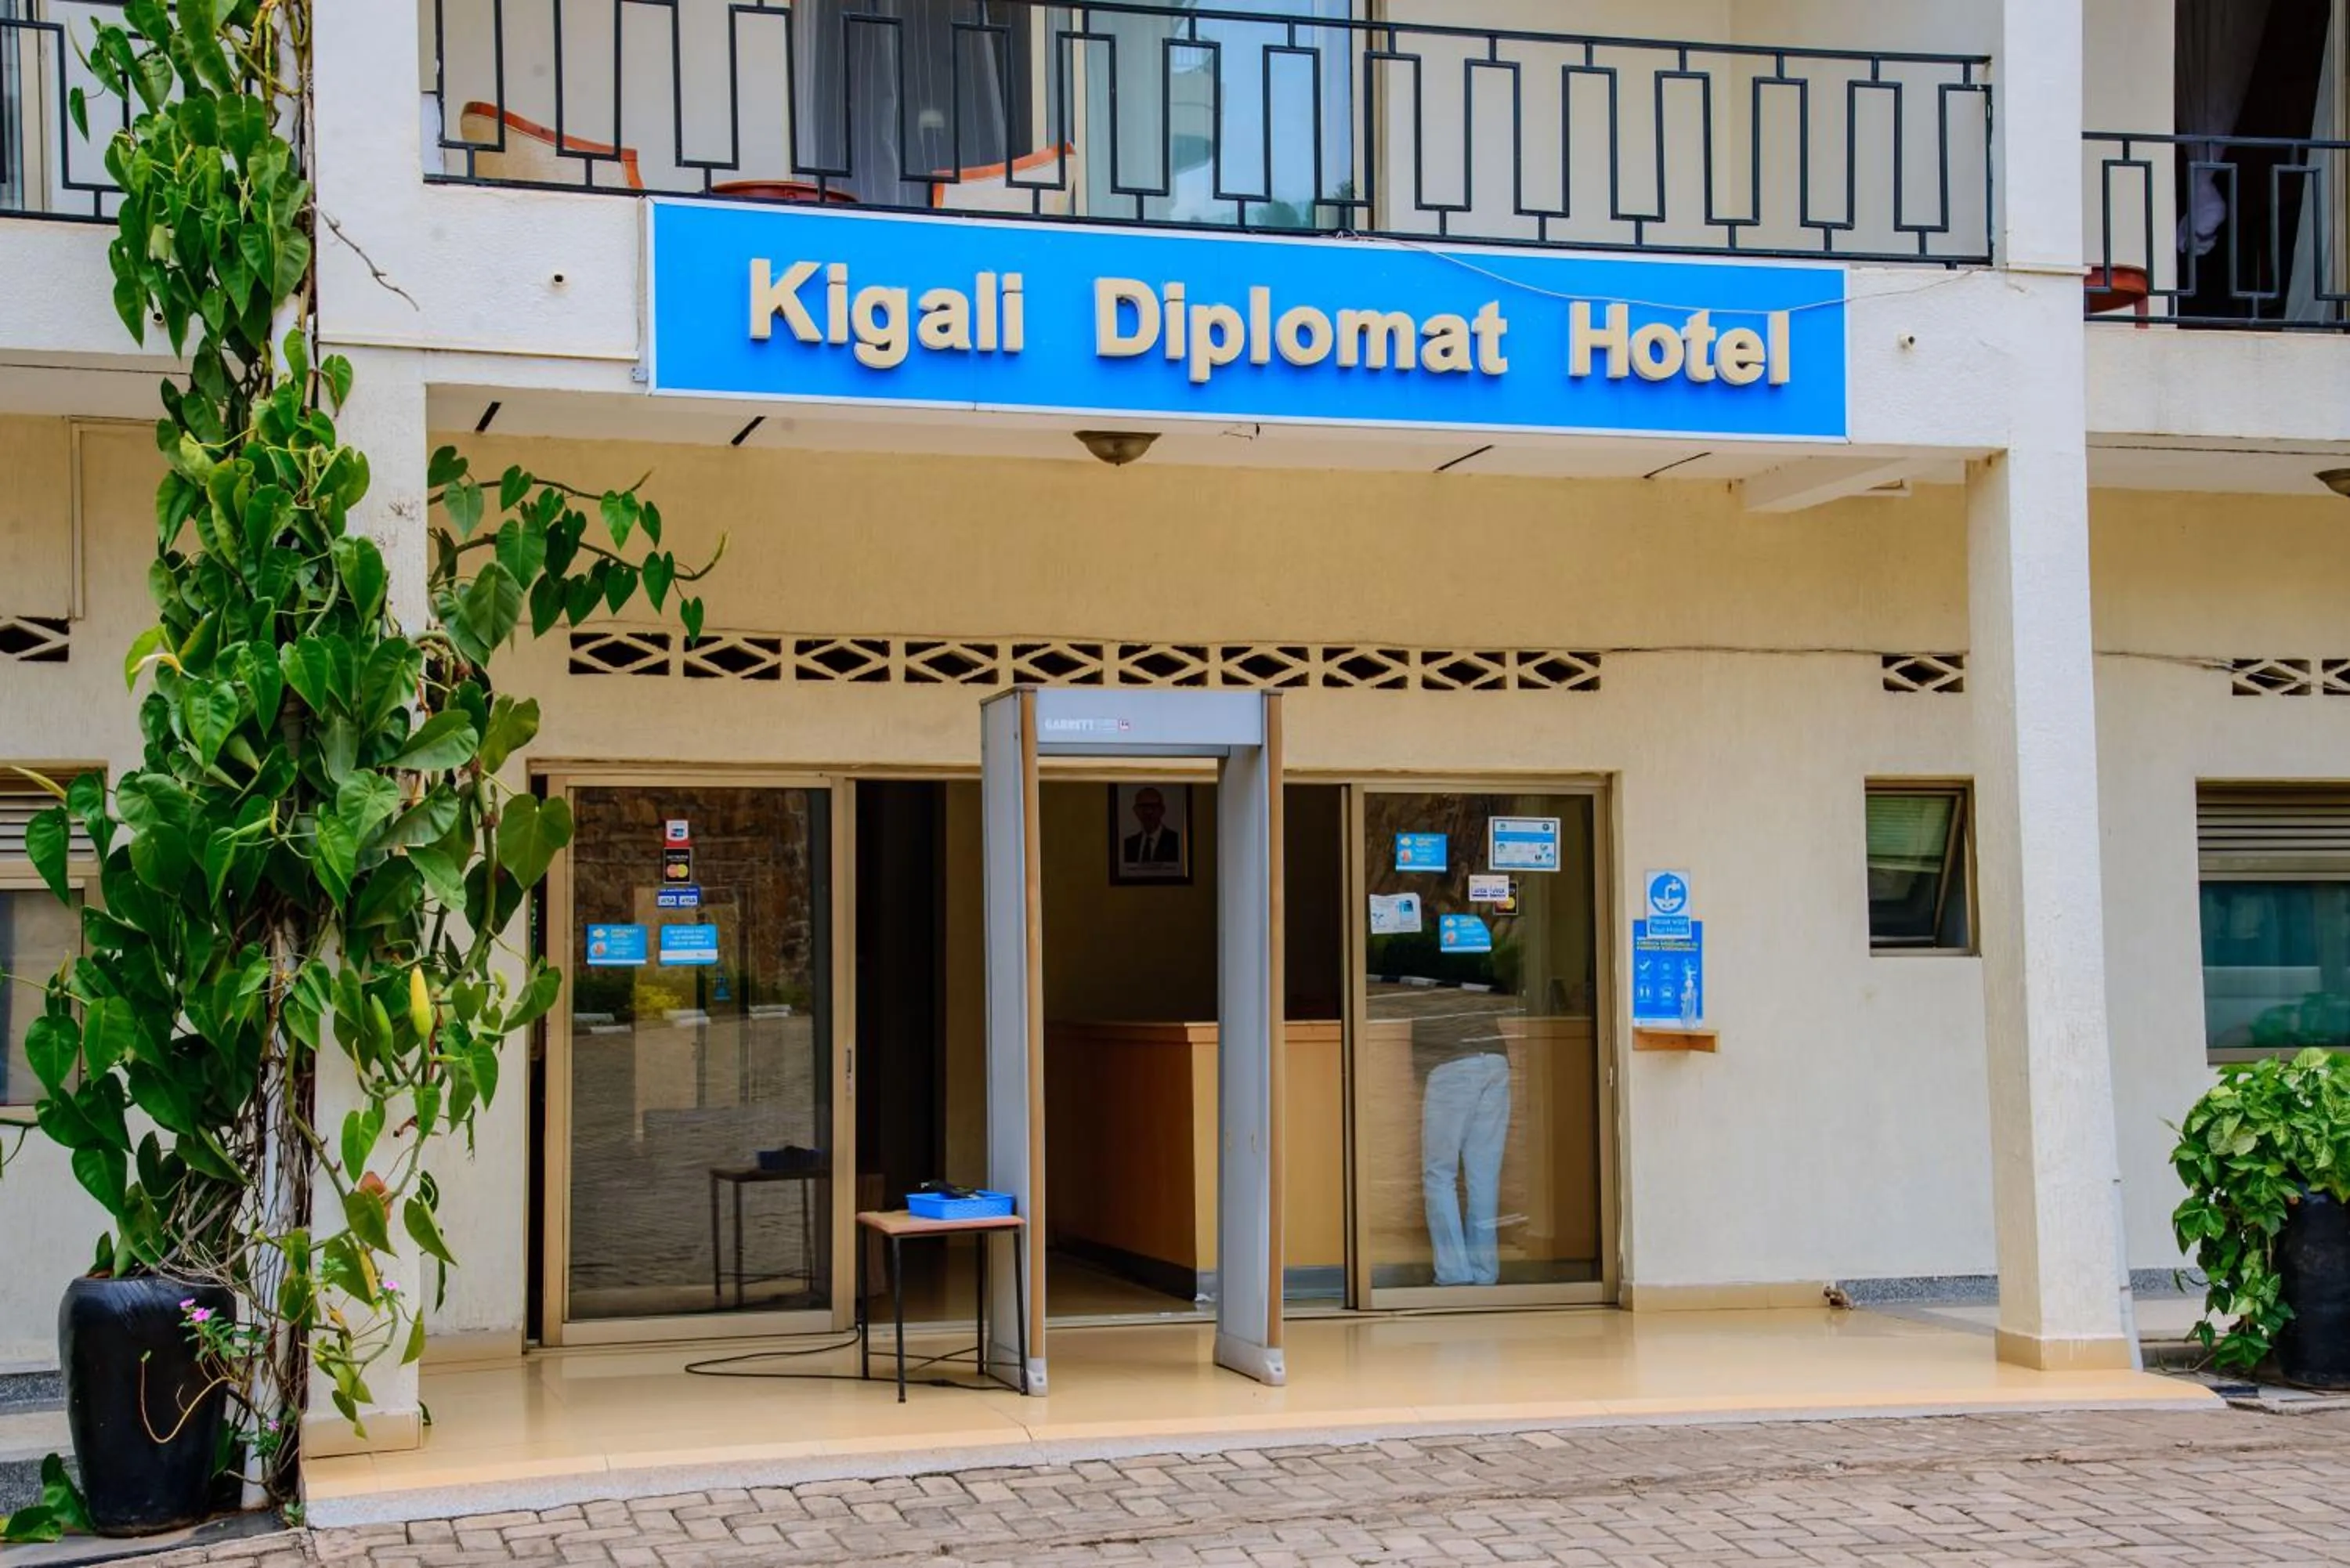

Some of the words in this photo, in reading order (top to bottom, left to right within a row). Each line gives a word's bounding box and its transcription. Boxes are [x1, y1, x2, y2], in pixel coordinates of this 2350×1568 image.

[750, 258, 1024, 368] Kigali
[1095, 277, 1509, 382] Diplomat
[1569, 301, 1791, 384] Hotel
